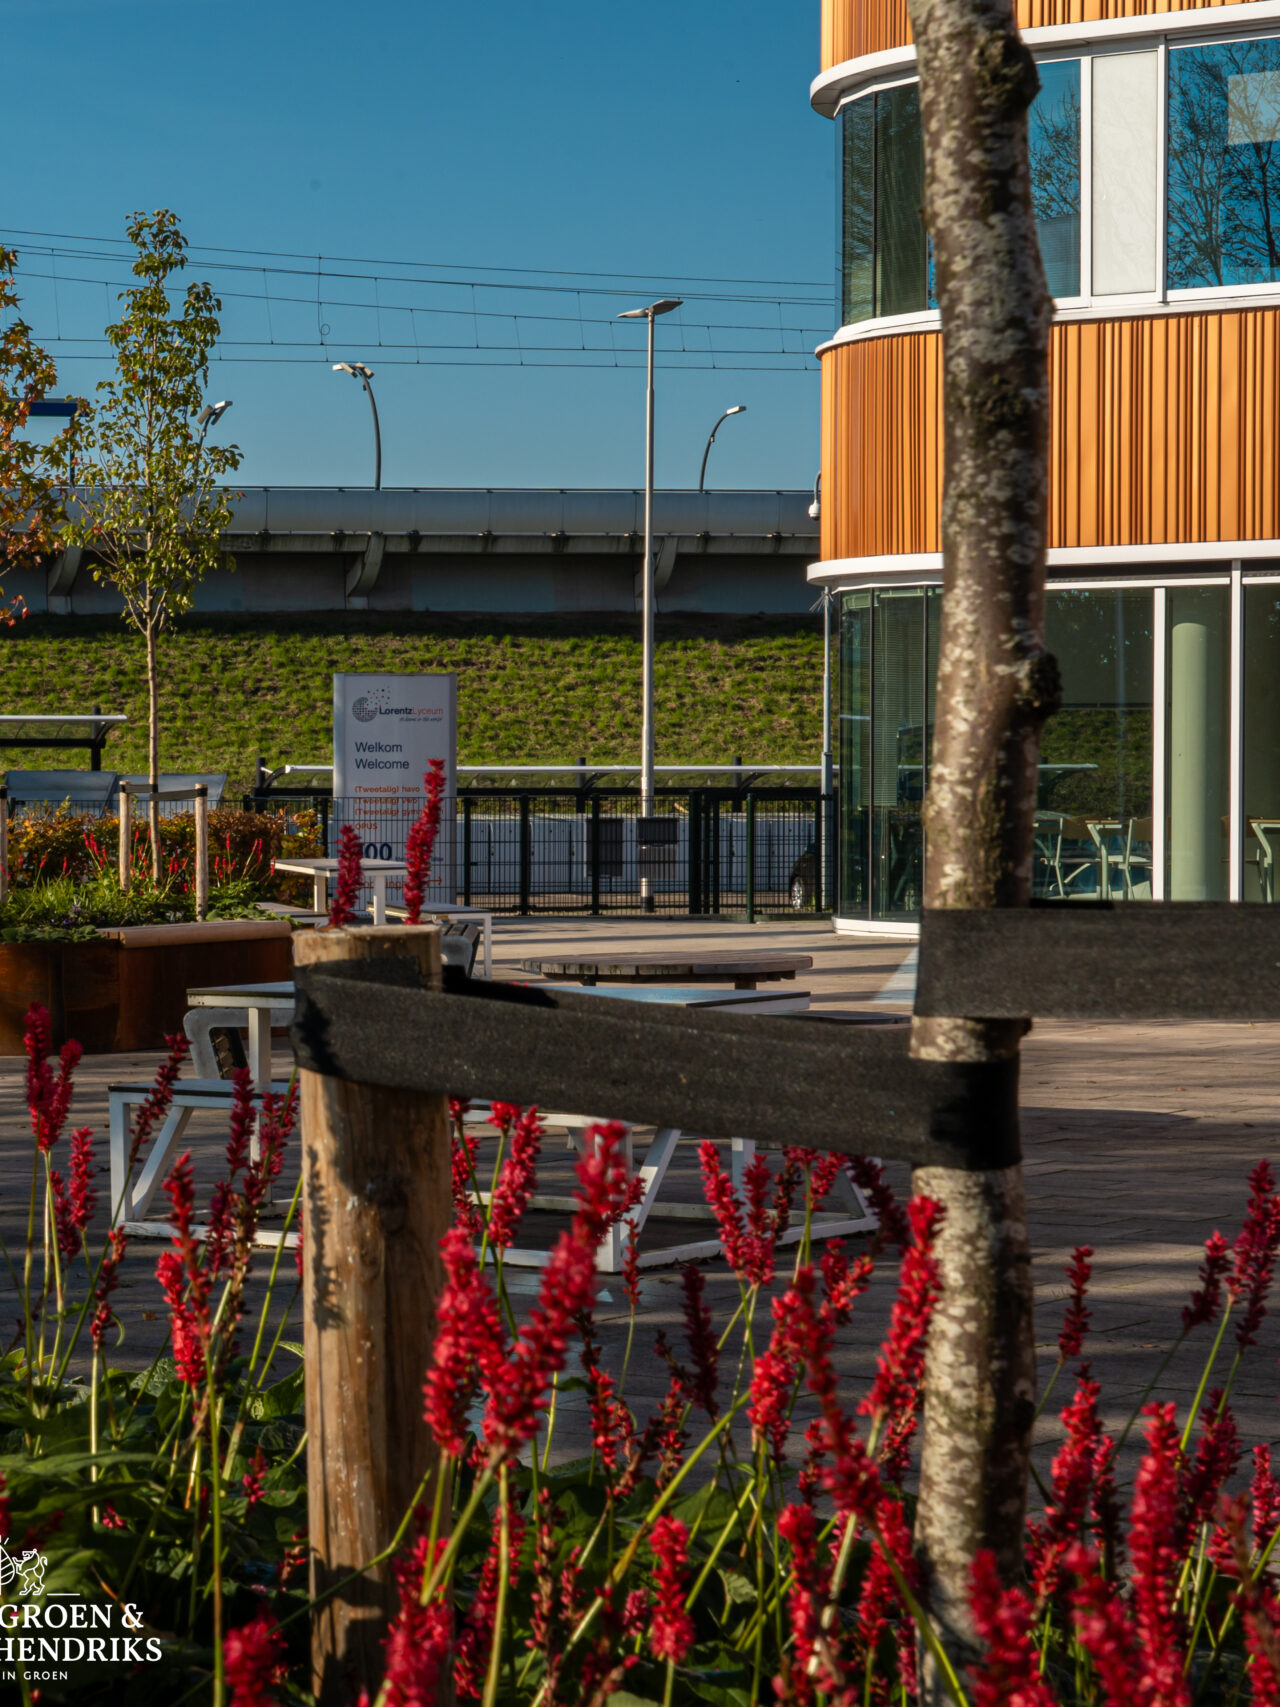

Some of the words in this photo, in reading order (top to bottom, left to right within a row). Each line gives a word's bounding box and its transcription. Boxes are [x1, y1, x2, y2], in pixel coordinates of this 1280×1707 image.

[355, 741, 403, 753] Welkom
[355, 758, 410, 770] Welcome
[354, 785, 399, 794] (Tweetalig)
[402, 785, 421, 793] havo
[355, 822, 378, 831] OPUS
